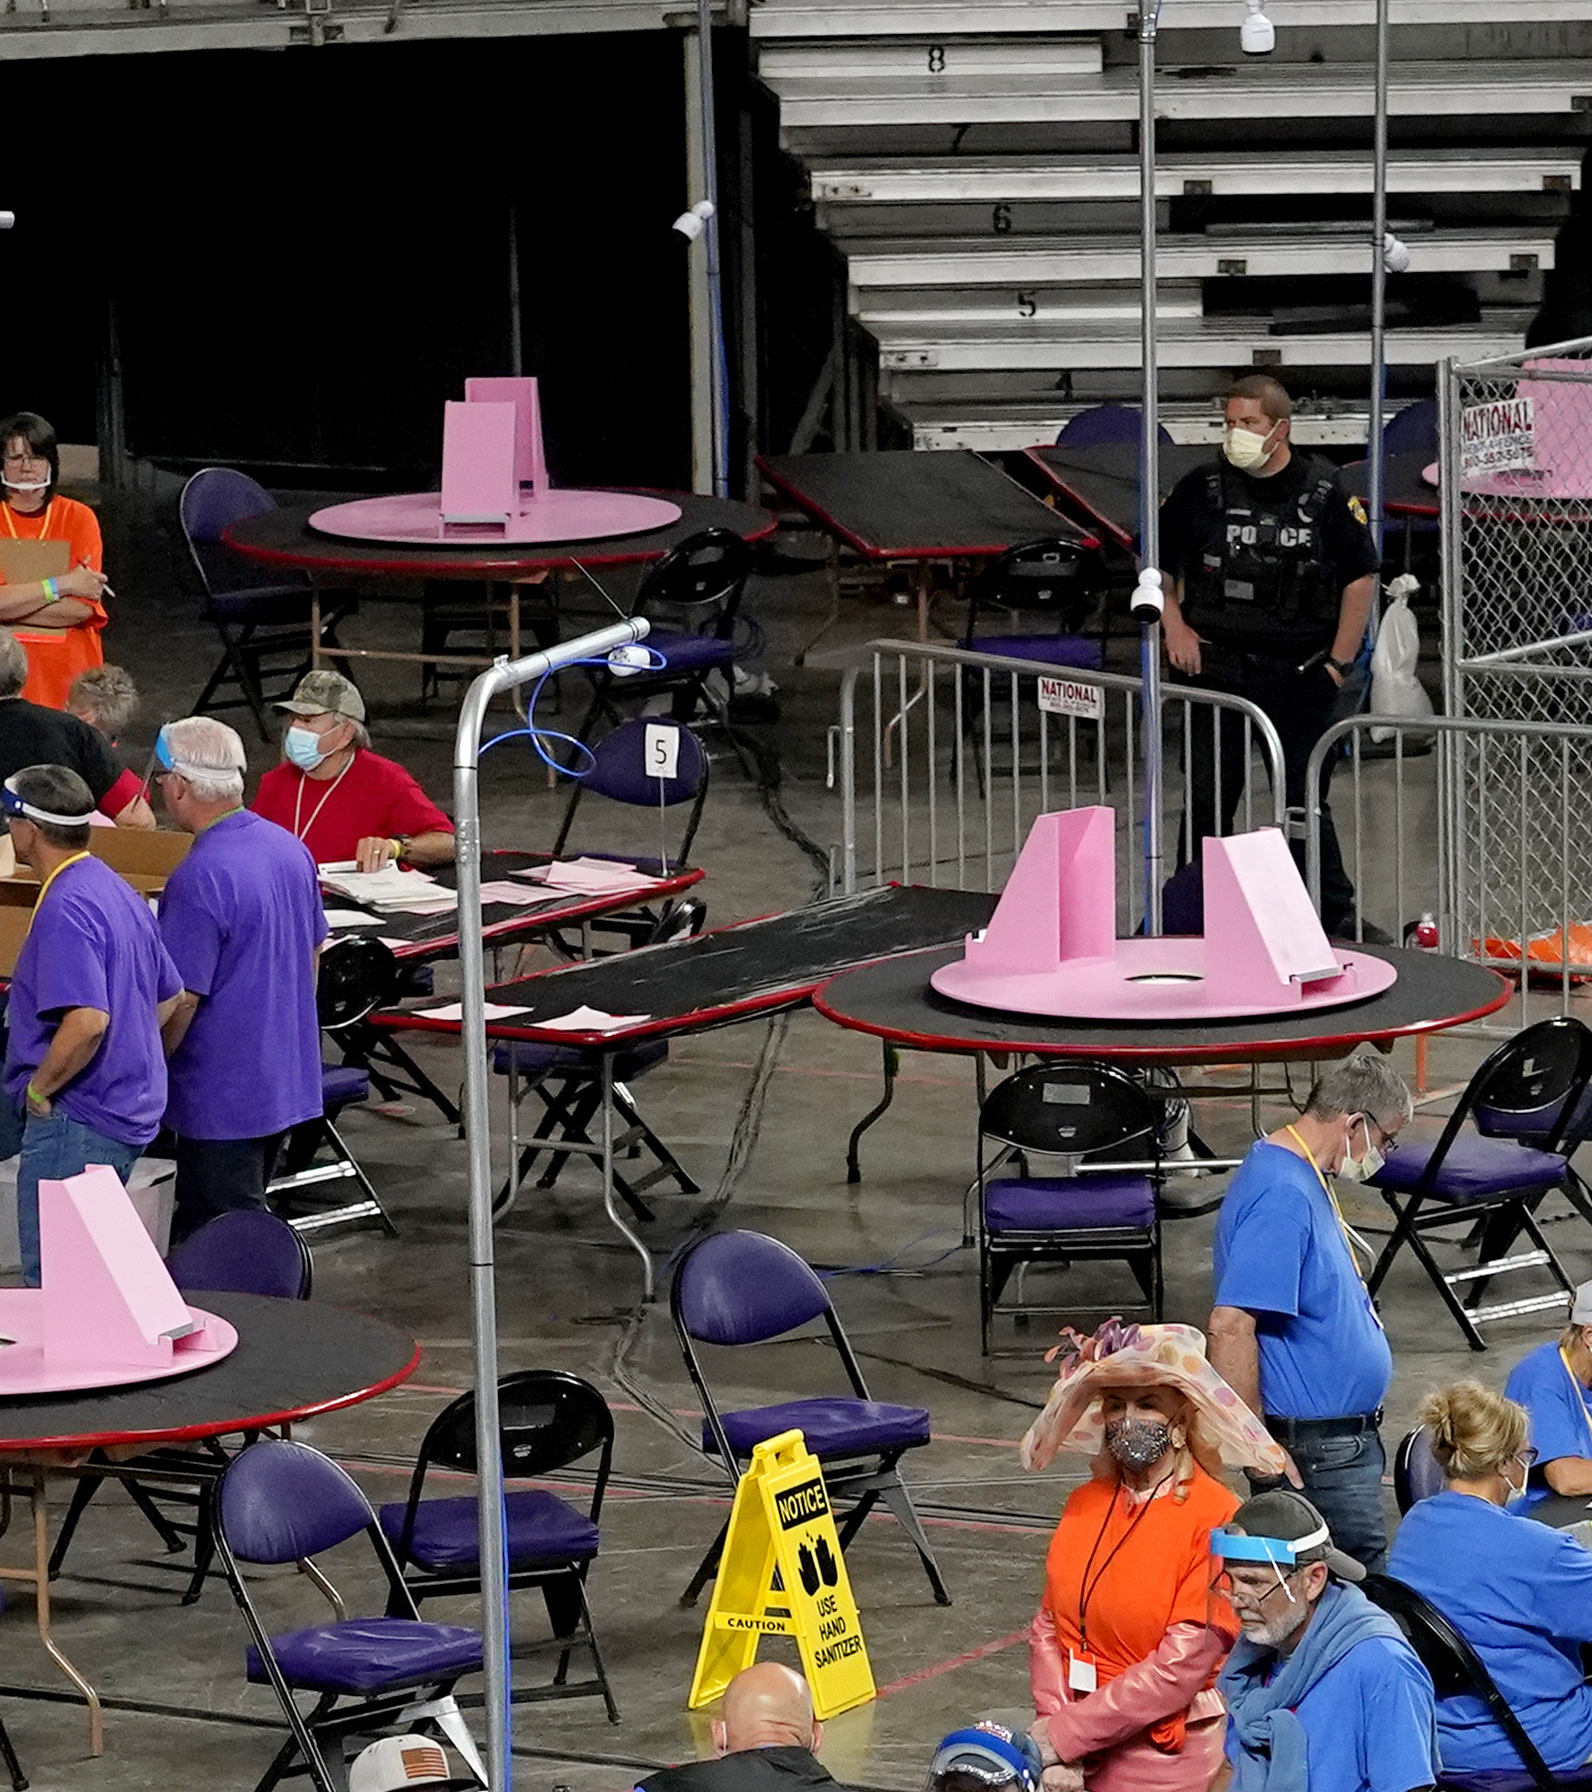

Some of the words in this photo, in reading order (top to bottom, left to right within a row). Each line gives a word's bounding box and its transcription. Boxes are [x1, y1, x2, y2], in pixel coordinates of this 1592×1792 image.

[928, 45, 945, 72] 8
[993, 203, 1011, 234] 6
[1018, 290, 1036, 317] 5
[1226, 524, 1312, 547] POCE
[1041, 680, 1097, 704] NATIONAL
[654, 739, 667, 765] 5
[778, 1484, 826, 1524] NOTICE
[816, 1595, 838, 1618] USE
[727, 1617, 785, 1632] CAUTION
[818, 1616, 847, 1642] HAND
[814, 1635, 863, 1669] SANITIZER
